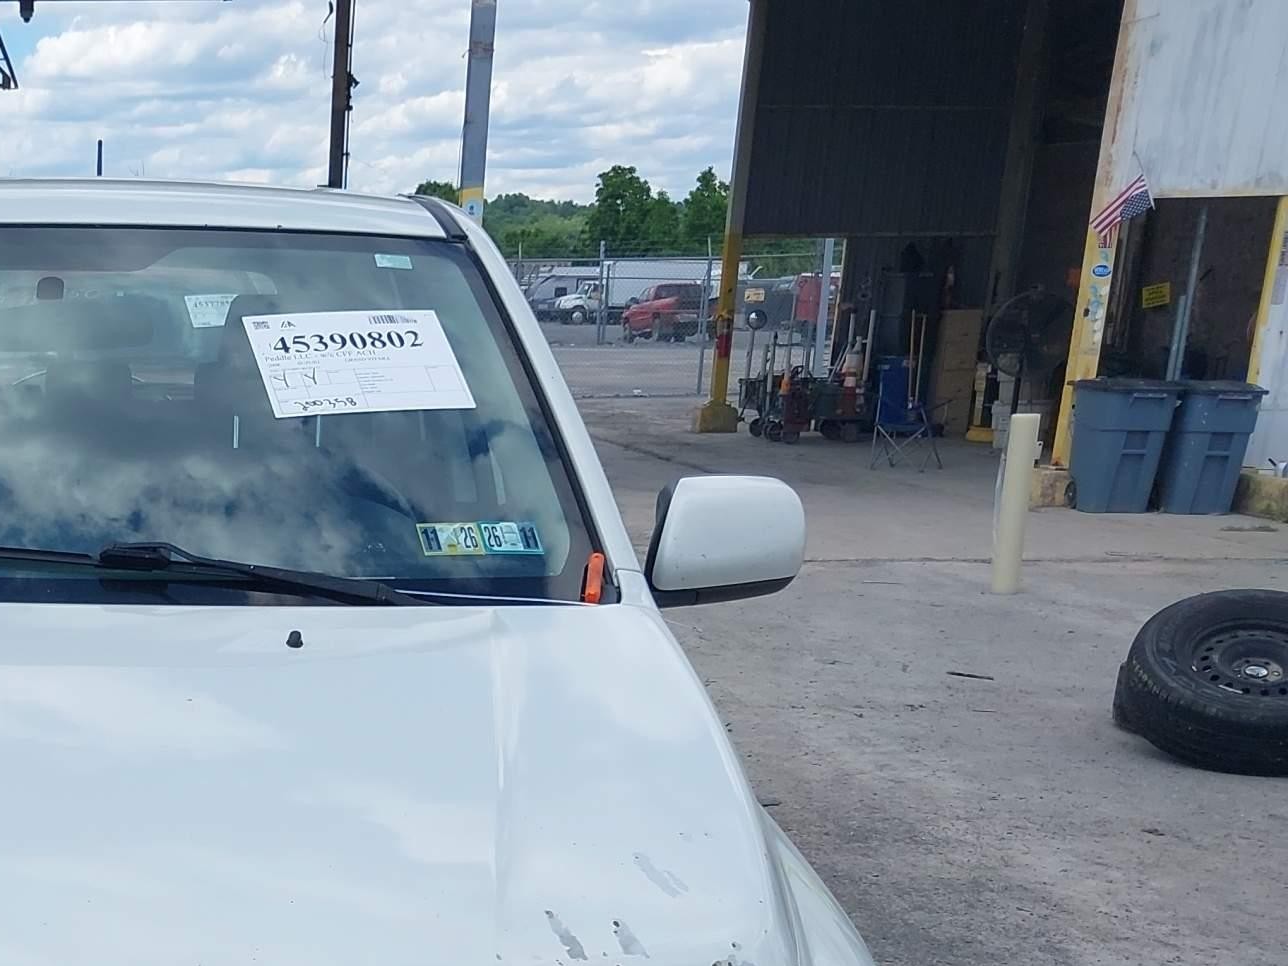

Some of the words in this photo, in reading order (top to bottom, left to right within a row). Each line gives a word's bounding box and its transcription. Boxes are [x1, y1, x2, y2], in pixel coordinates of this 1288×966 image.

[273, 331, 424, 354] 45390802
[304, 367, 318, 385] Y
[294, 397, 358, 412] 200358
[460, 526, 479, 548] 26
[484, 526, 503, 547] 26
